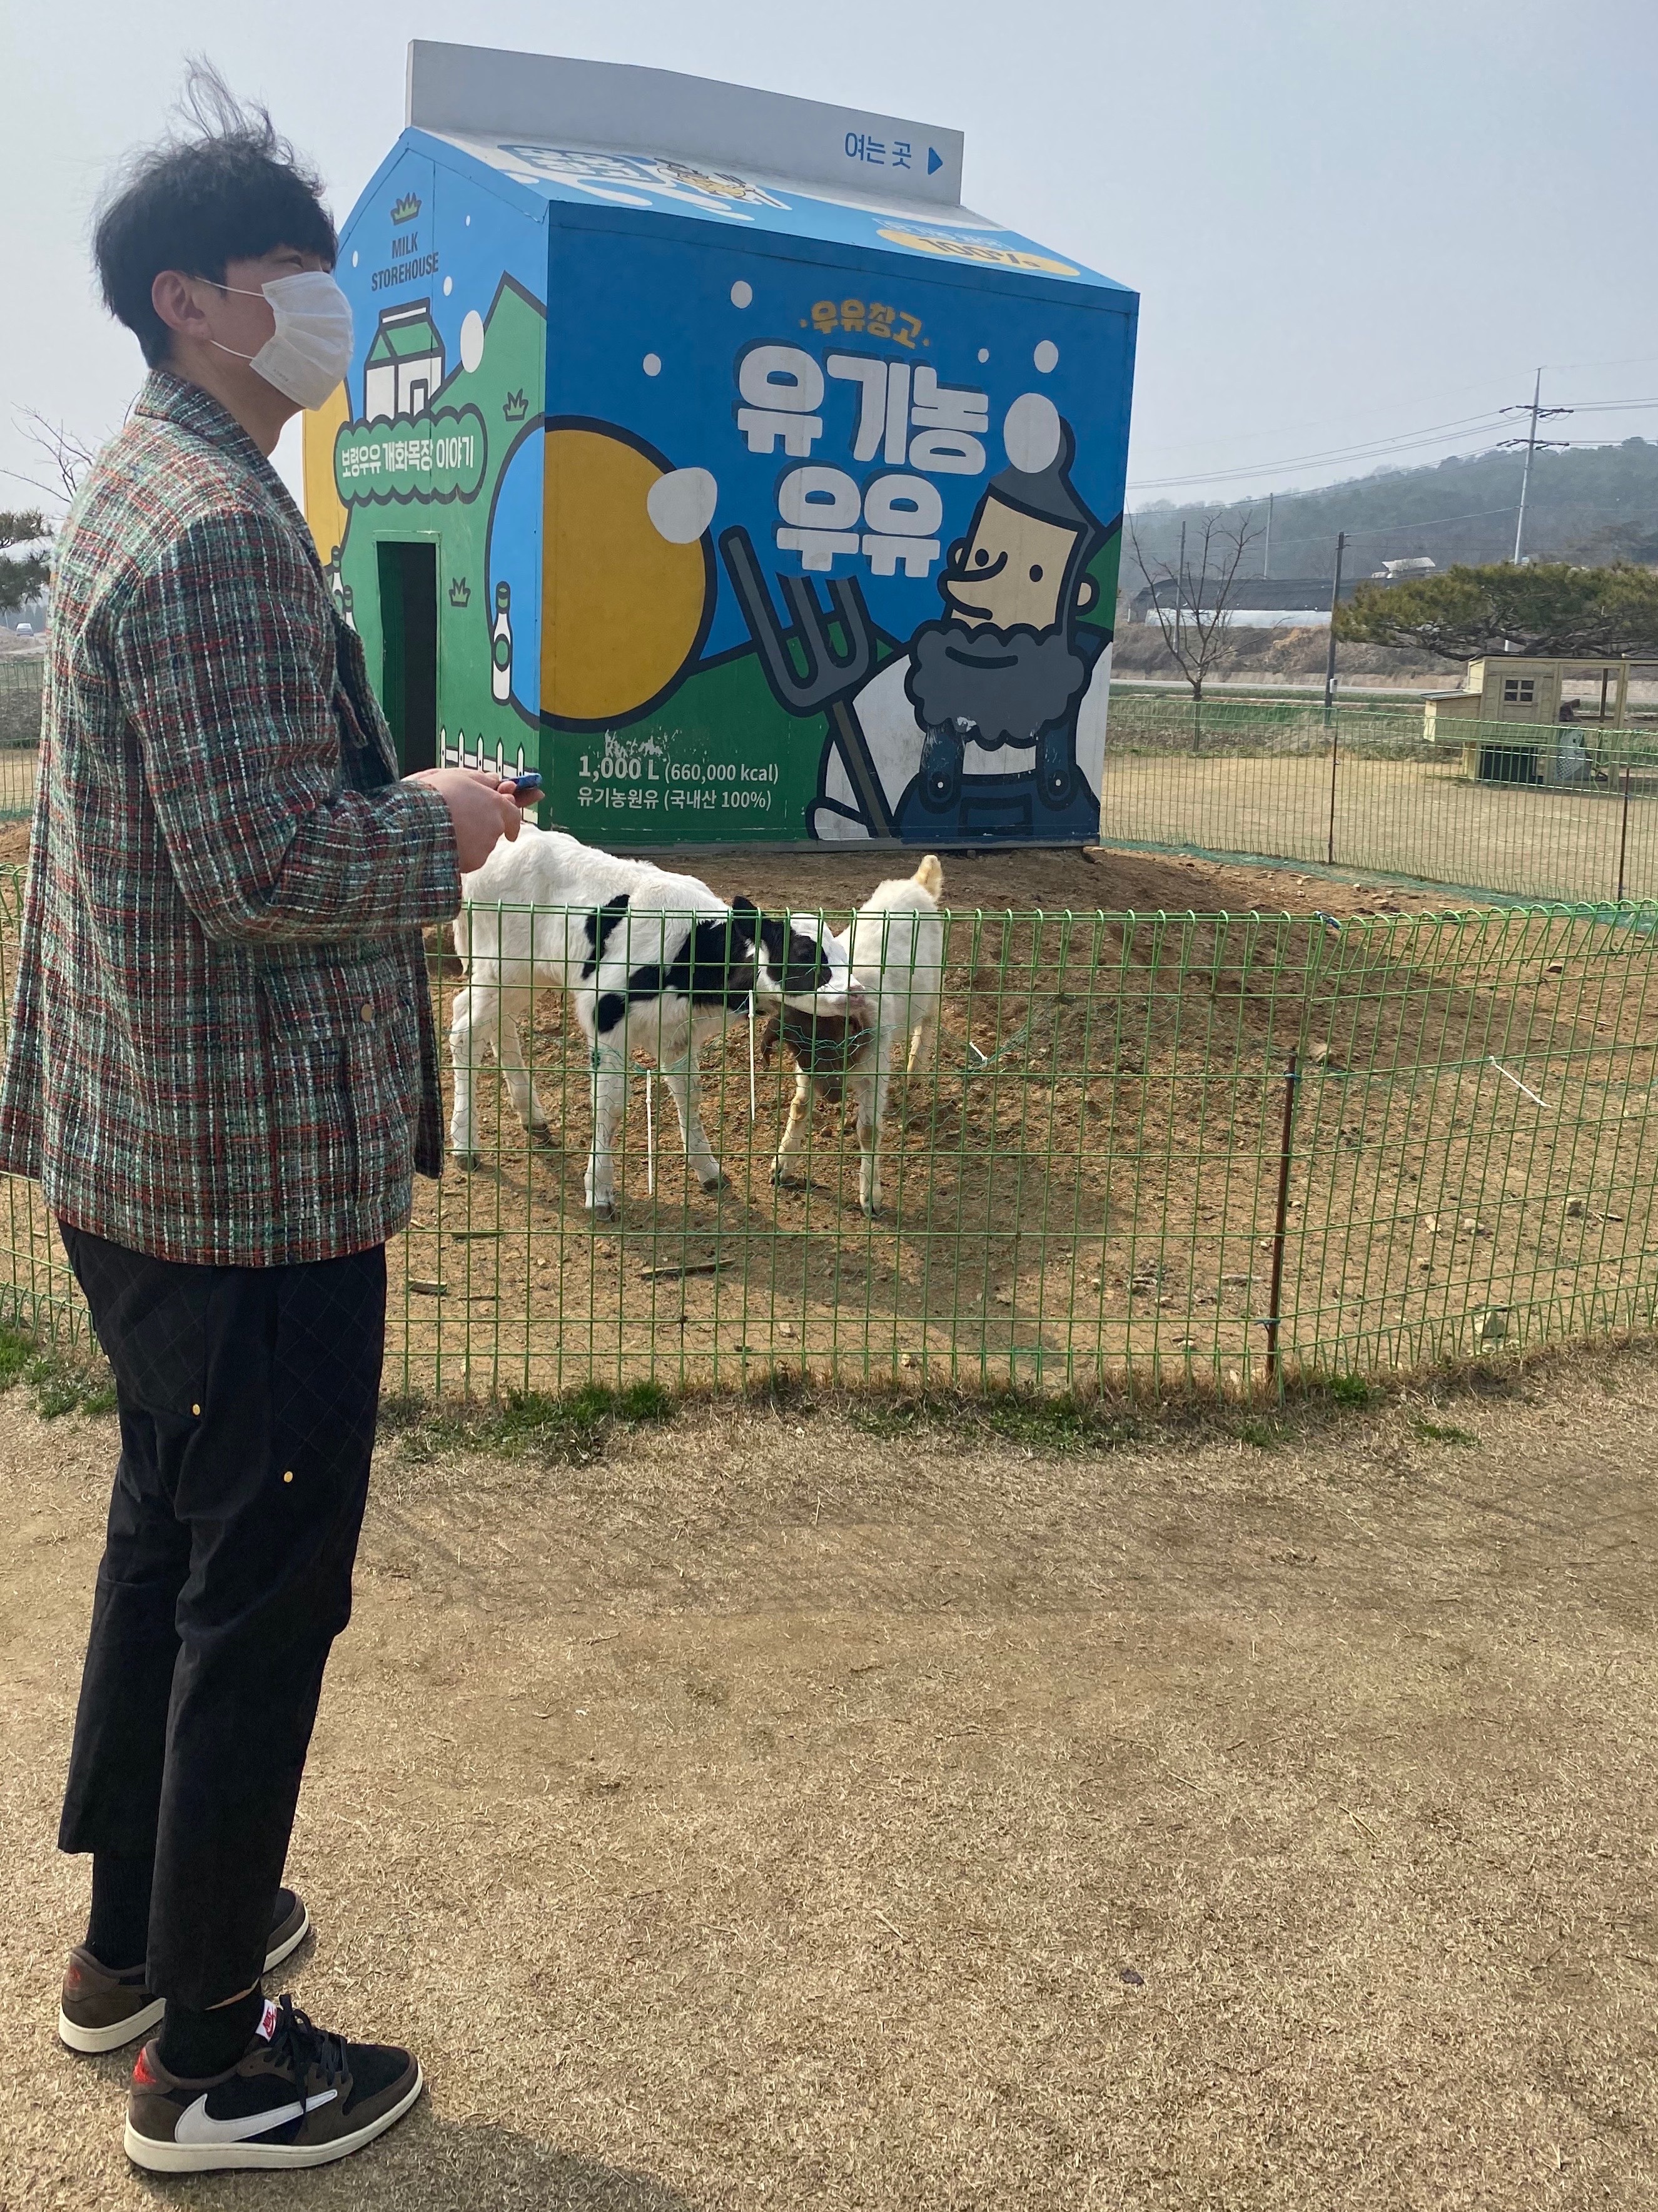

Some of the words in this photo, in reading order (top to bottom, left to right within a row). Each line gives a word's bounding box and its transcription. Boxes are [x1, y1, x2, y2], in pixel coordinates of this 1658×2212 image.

[845, 132, 886, 165] 여는
[892, 141, 911, 170] 곳
[392, 231, 418, 259] MILK
[919, 238, 1041, 268] 100%
[371, 251, 440, 292] STOREHOUSE
[811, 299, 923, 350] 우유창고
[737, 345, 989, 476] 유기농
[341, 444, 381, 477] 보령우유
[382, 438, 433, 473] 개화목장
[435, 435, 475, 470] 이야기
[776, 466, 943, 579] 우유
[579, 755, 642, 783] 1,000
[647, 759, 659, 781] L
[664, 762, 737, 785] (660,000
[740, 763, 779, 785] kcal)
[577, 786, 659, 810] 유기농원유
[664, 788, 717, 811] (국내산
[721, 790, 772, 811] 100%)
